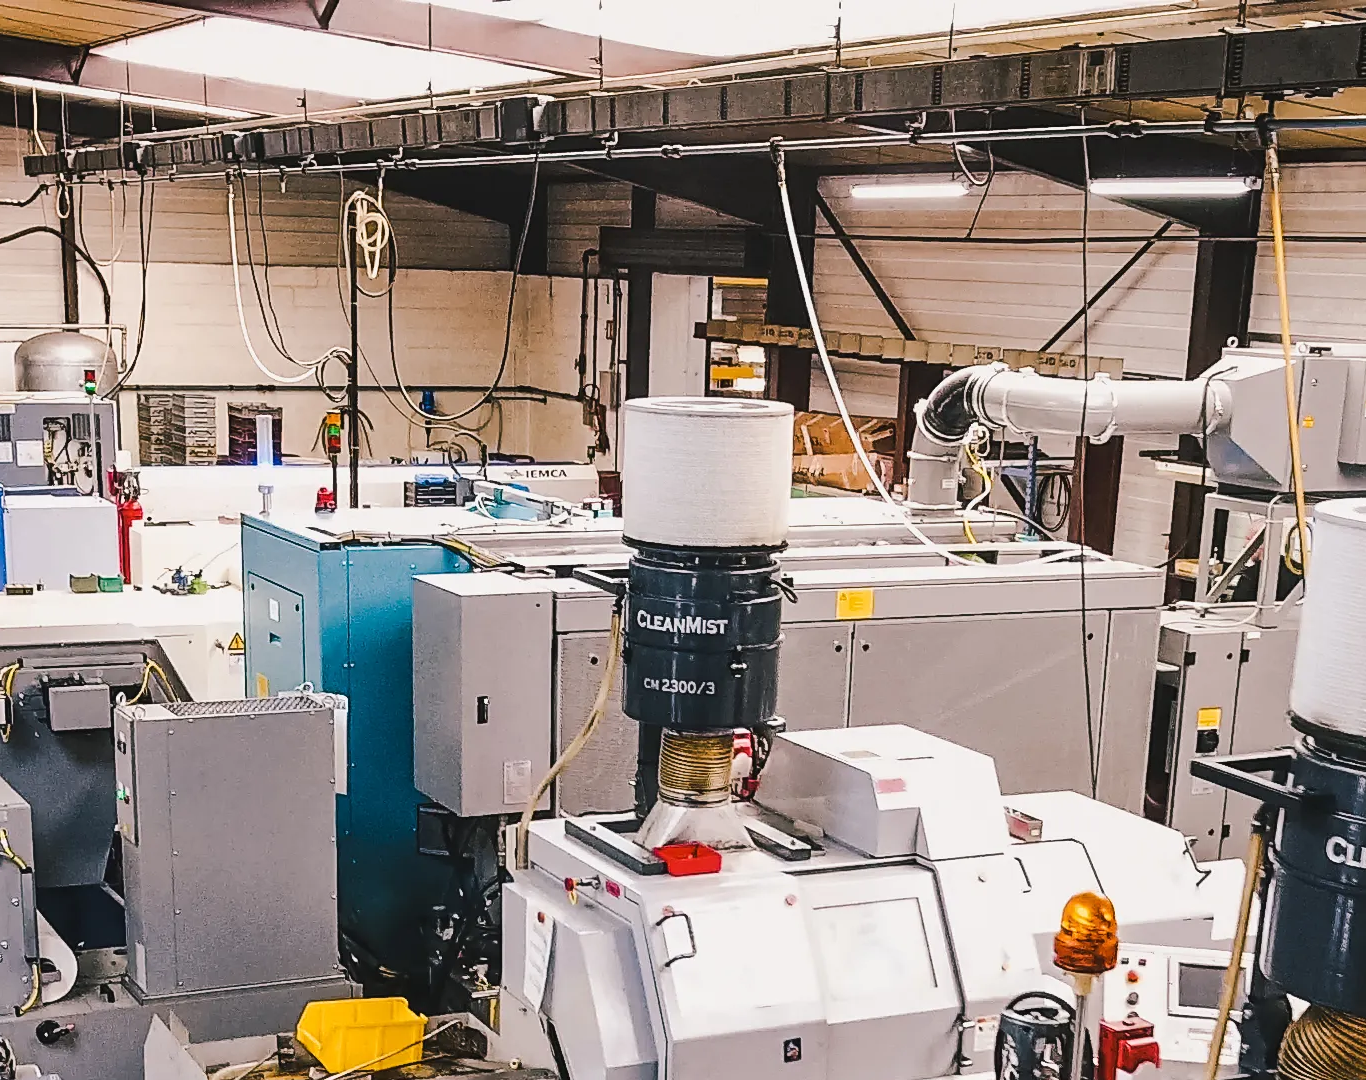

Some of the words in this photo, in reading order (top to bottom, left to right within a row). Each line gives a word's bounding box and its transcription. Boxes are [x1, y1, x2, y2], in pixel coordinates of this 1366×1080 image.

[526, 469, 567, 478] IEMCA
[643, 678, 660, 691] CM
[661, 679, 716, 694] 2300/3
